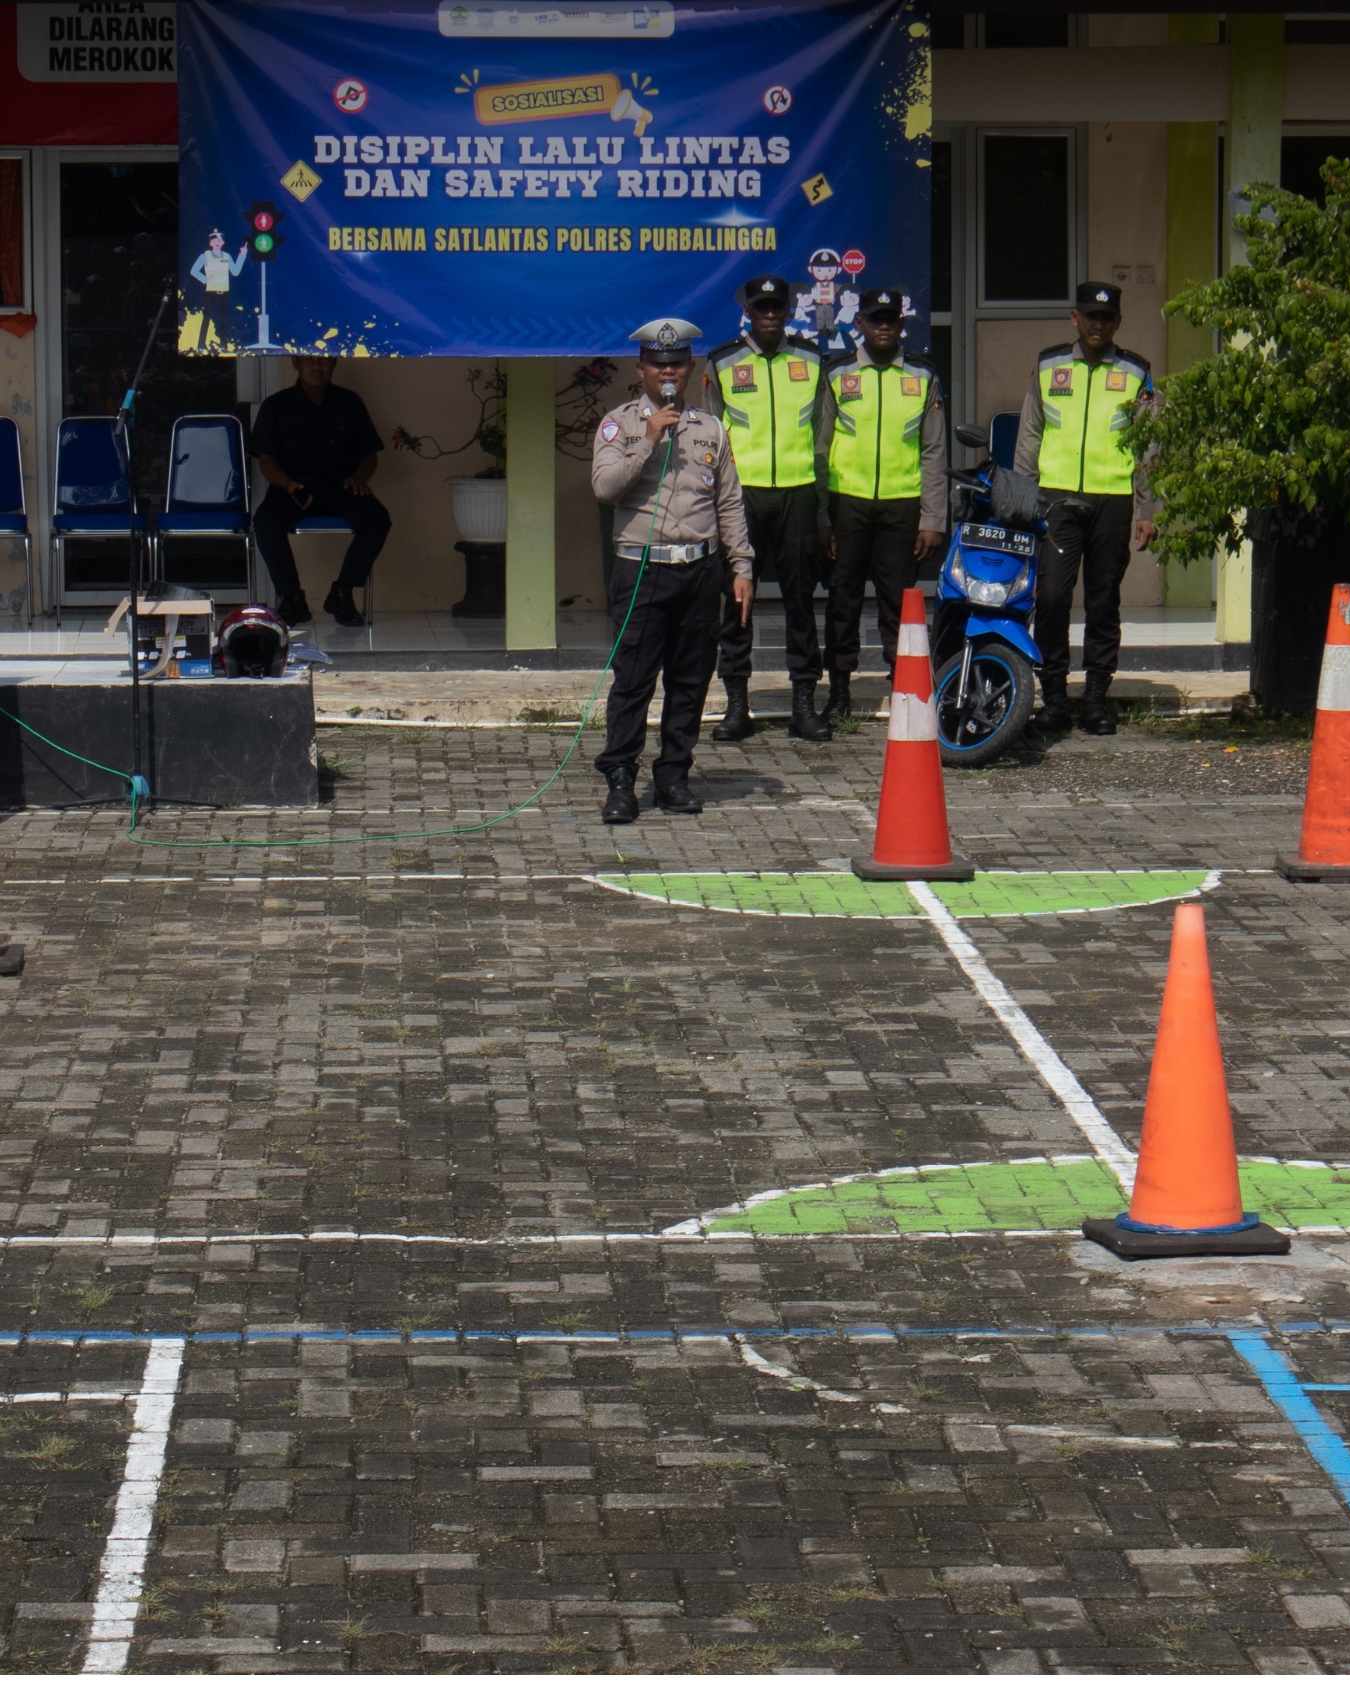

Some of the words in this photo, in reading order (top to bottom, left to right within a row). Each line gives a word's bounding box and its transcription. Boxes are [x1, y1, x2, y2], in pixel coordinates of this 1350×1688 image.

[50, 16, 174, 41] DILARANG
[50, 46, 174, 71] MEROKOK
[492, 85, 604, 113] SOSIALISASI
[314, 136, 504, 165] DISIPLIN
[519, 136, 625, 165] LALU
[640, 136, 790, 166] LINTAS
[344, 170, 431, 198] DAN
[446, 170, 604, 198] SAFETY
[617, 170, 762, 198] RIDING
[329, 227, 427, 251] BERSAMA
[434, 228, 549, 252] SATLANTAS
[557, 228, 632, 252] POLRES
[640, 228, 777, 252] PURBALINGGA
[963, 525, 970, 535] R
[978, 528, 1006, 540] 3620
[1014, 534, 1030, 545] DM
